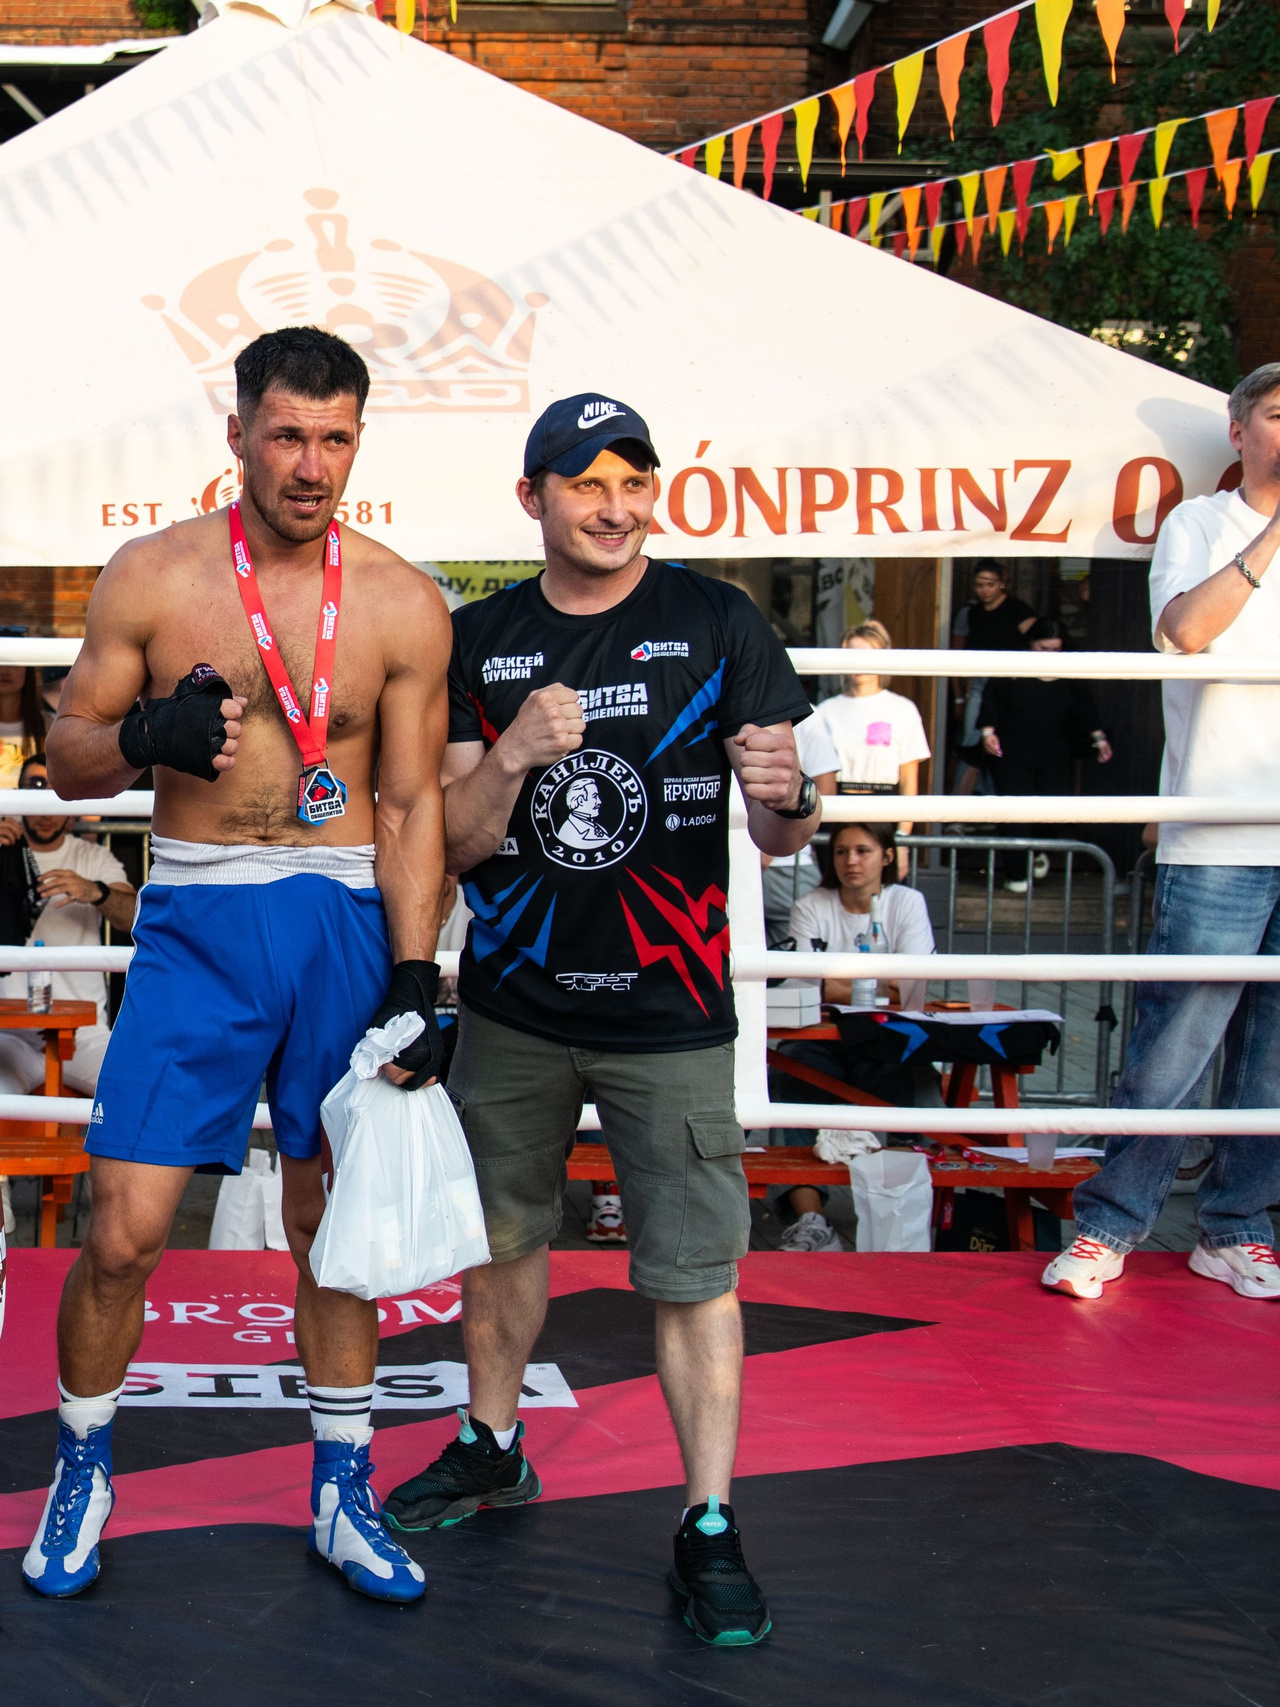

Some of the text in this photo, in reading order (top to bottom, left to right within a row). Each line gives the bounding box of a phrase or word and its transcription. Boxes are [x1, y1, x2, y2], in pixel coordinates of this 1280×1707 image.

[584, 401, 618, 419] NIKE
[647, 440, 1073, 543] ÓNPRINZ
[481, 651, 544, 672] АЛЕКСЕЙ
[577, 682, 649, 711] БИТВА
[581, 704, 649, 723] БЩЕПИТОВ
[534, 754, 643, 820] КАНЦЛЕРЪ
[309, 800, 342, 814] БИТВА
[551, 840, 625, 864] 2010
